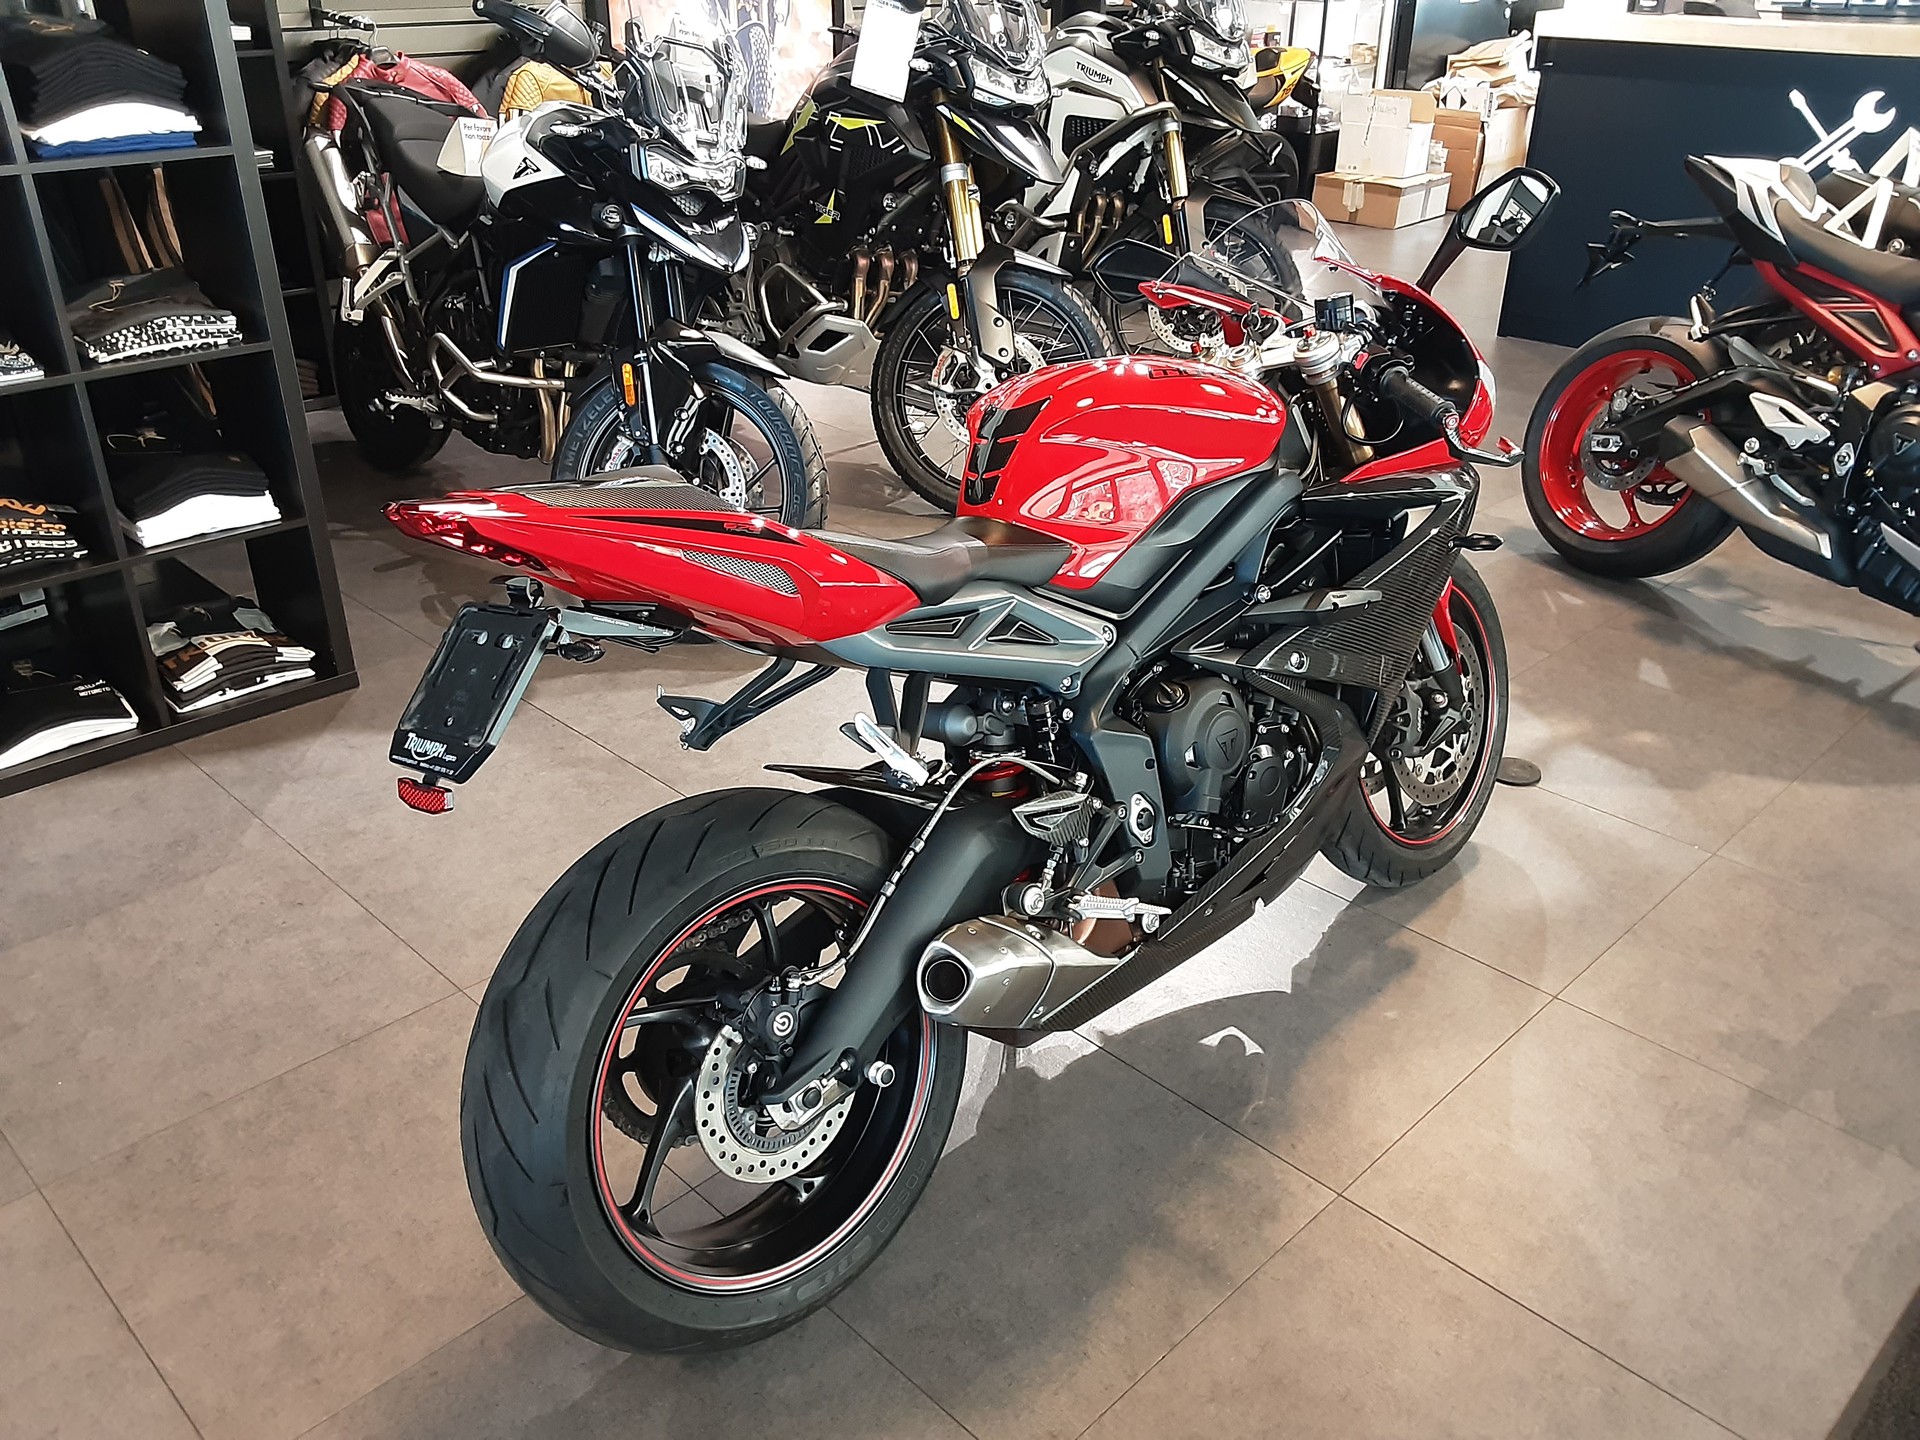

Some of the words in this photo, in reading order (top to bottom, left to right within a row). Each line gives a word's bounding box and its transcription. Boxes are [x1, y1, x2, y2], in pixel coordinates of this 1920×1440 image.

[1076, 61, 1113, 85] TRIUMPH
[814, 201, 841, 221] TIGER
[404, 732, 447, 760] TRIUMPH
[876, 1158, 927, 1233] ROSSO
